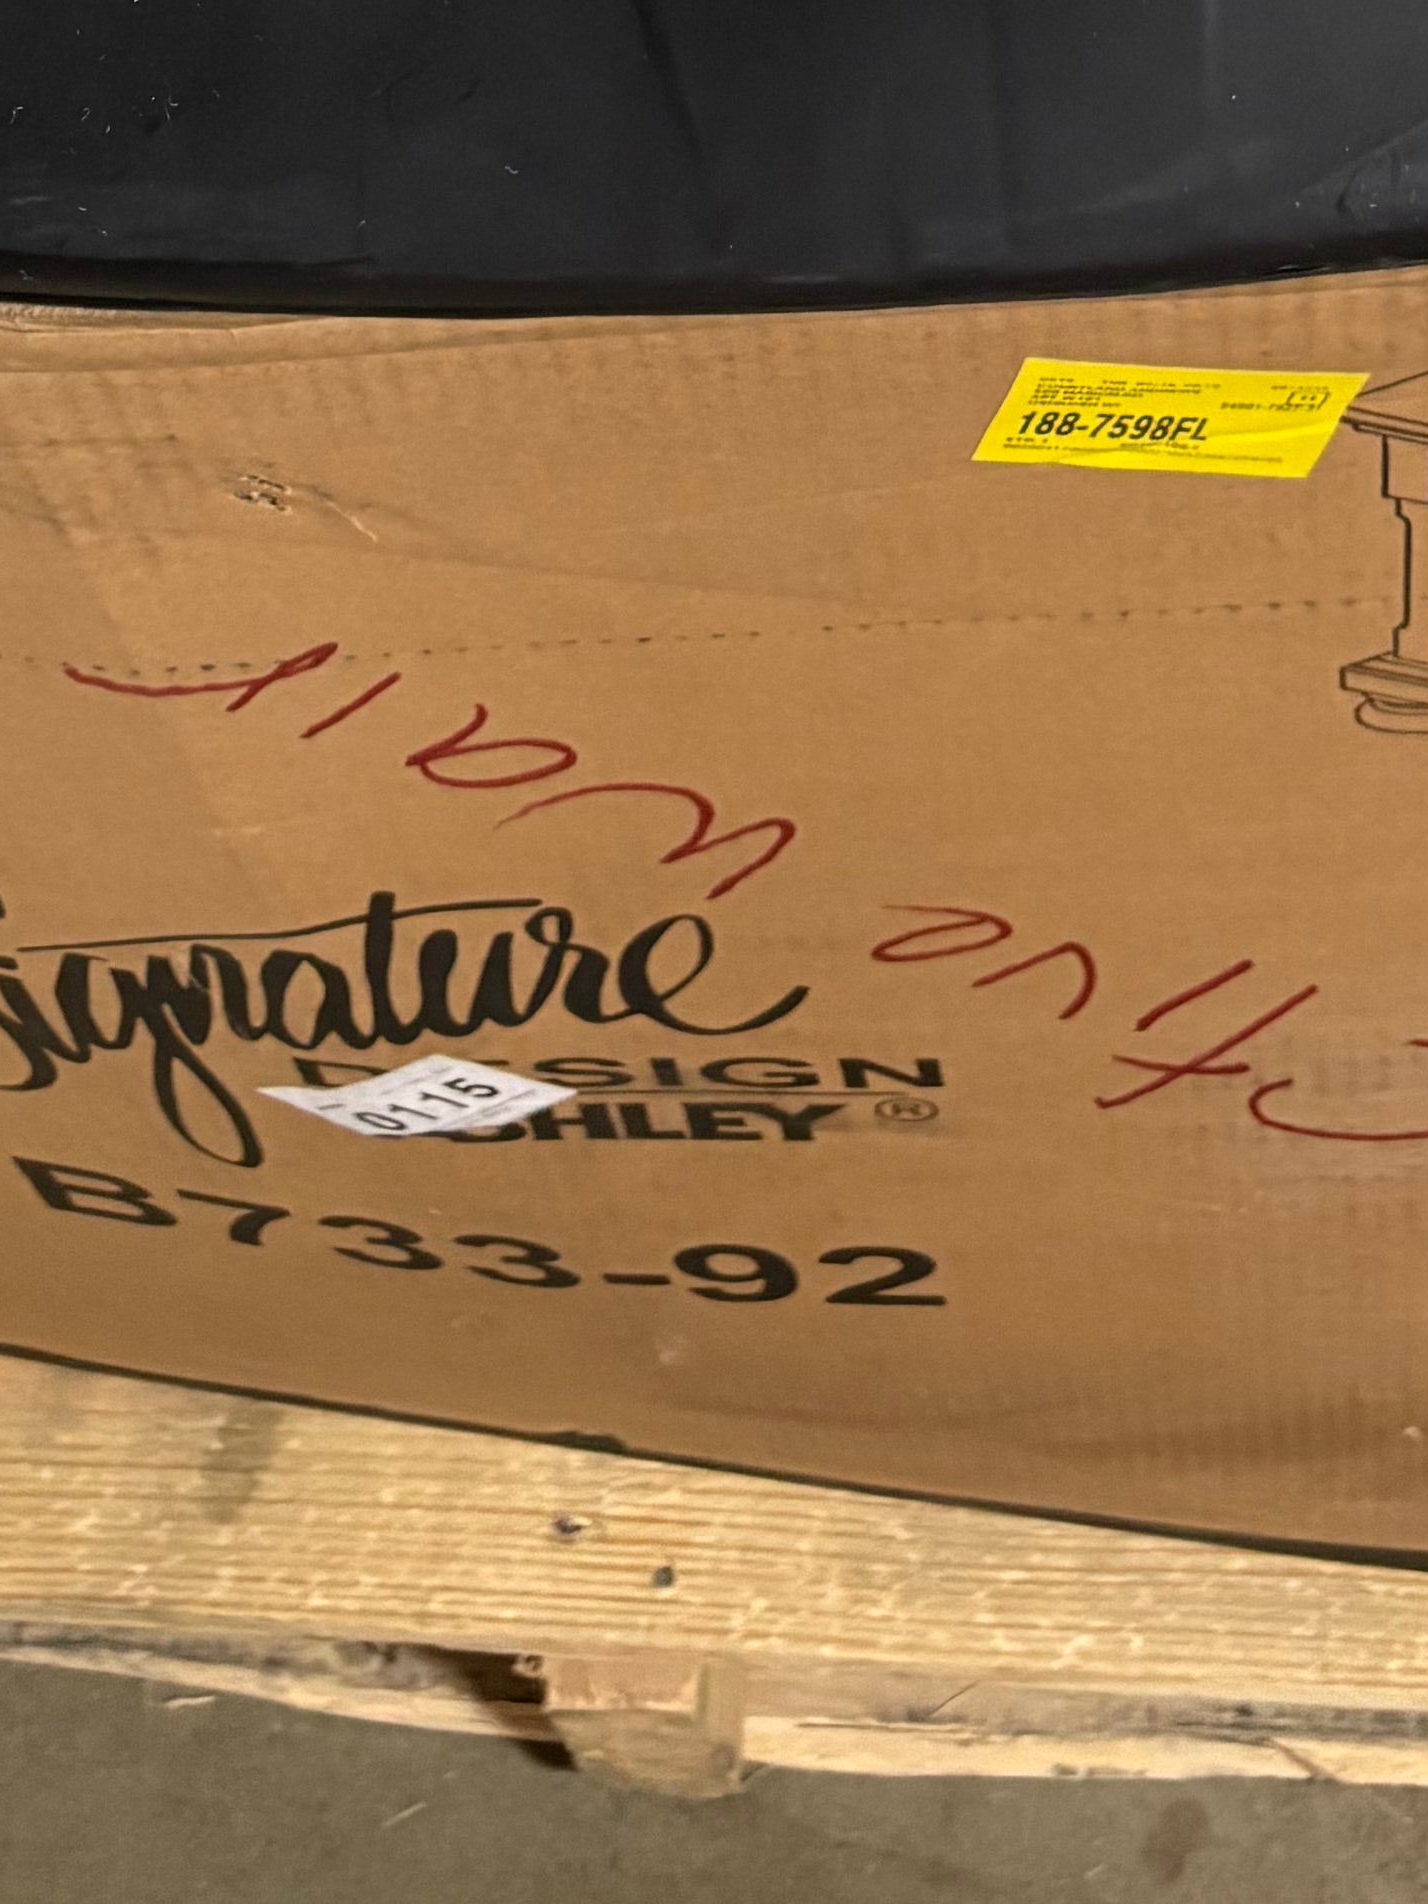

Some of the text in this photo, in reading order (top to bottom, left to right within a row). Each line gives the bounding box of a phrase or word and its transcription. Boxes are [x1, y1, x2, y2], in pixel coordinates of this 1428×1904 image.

[1017, 410, 1210, 442] 188-7598FL
[292, 1057, 945, 1090] DSIGN
[354, 1076, 499, 1132] 0115
[12, 1154, 948, 1306] B733-92
